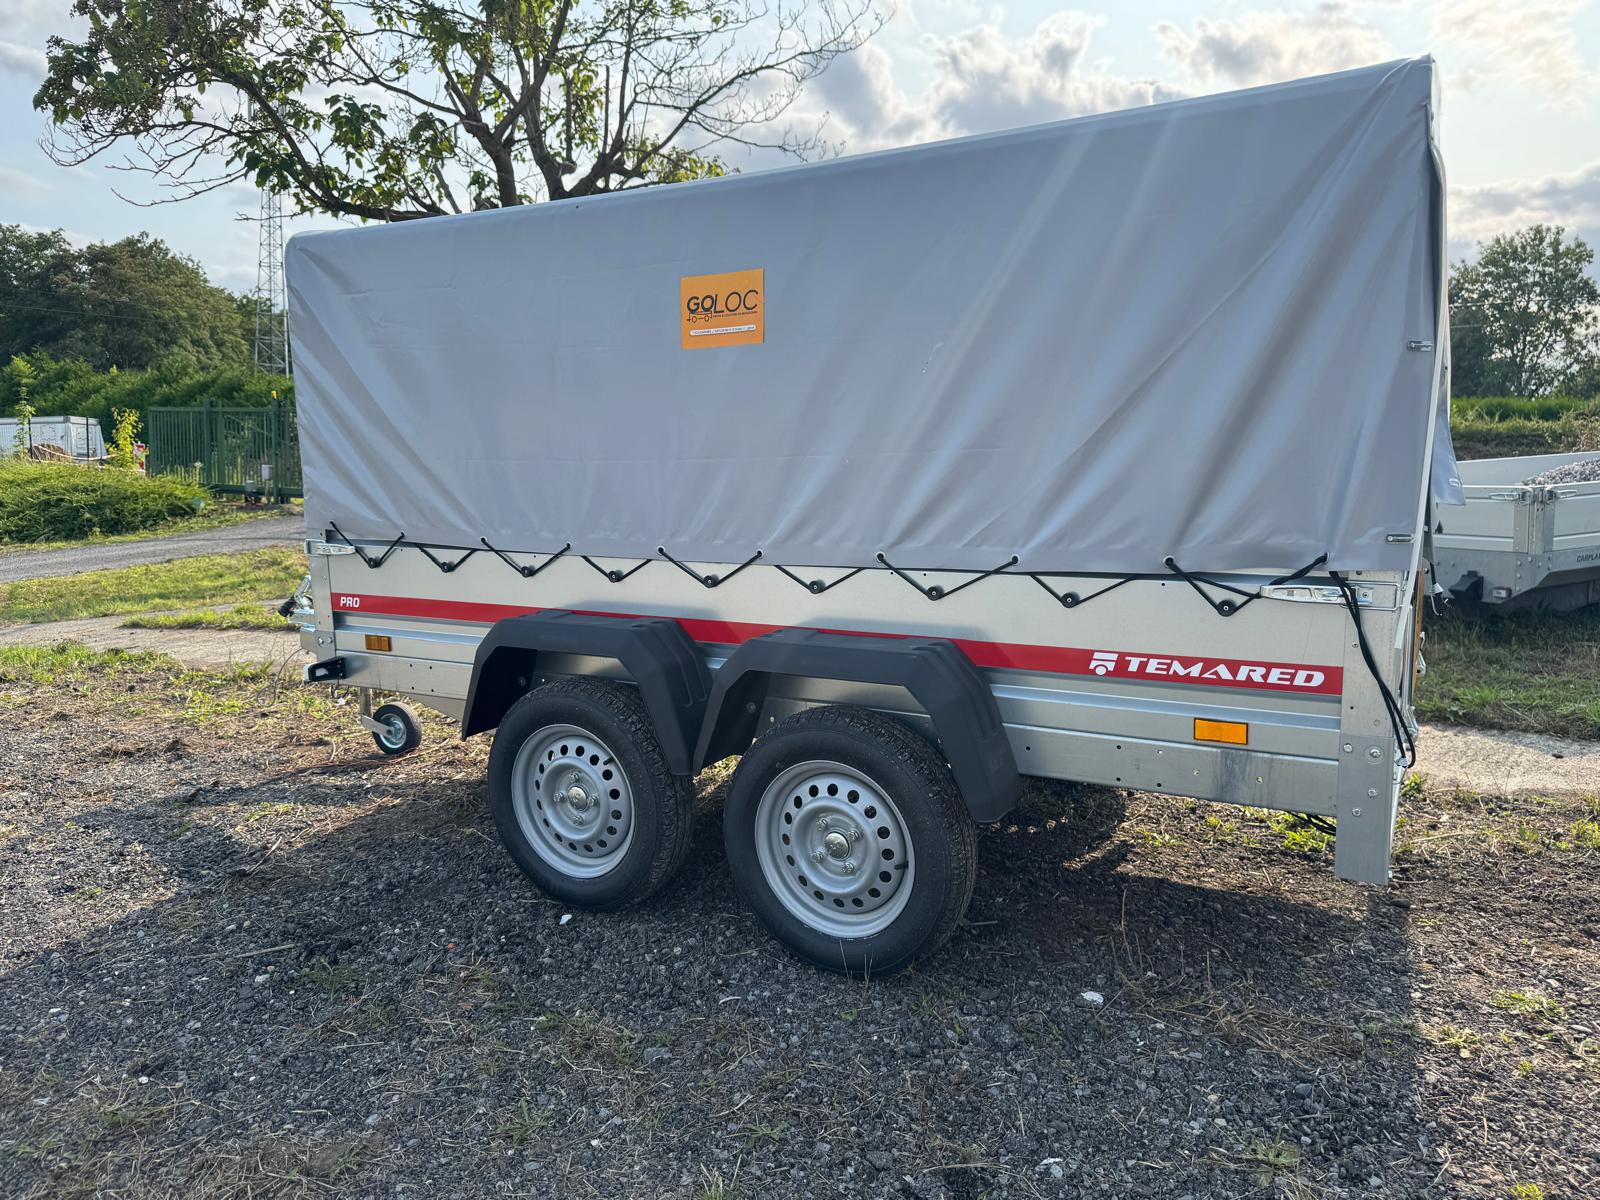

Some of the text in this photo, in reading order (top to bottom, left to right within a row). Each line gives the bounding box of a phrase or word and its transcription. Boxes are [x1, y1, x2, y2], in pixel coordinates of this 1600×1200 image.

[687, 289, 758, 314] GOLOC
[340, 596, 360, 608] PRO
[1125, 656, 1325, 687] TEMARED
